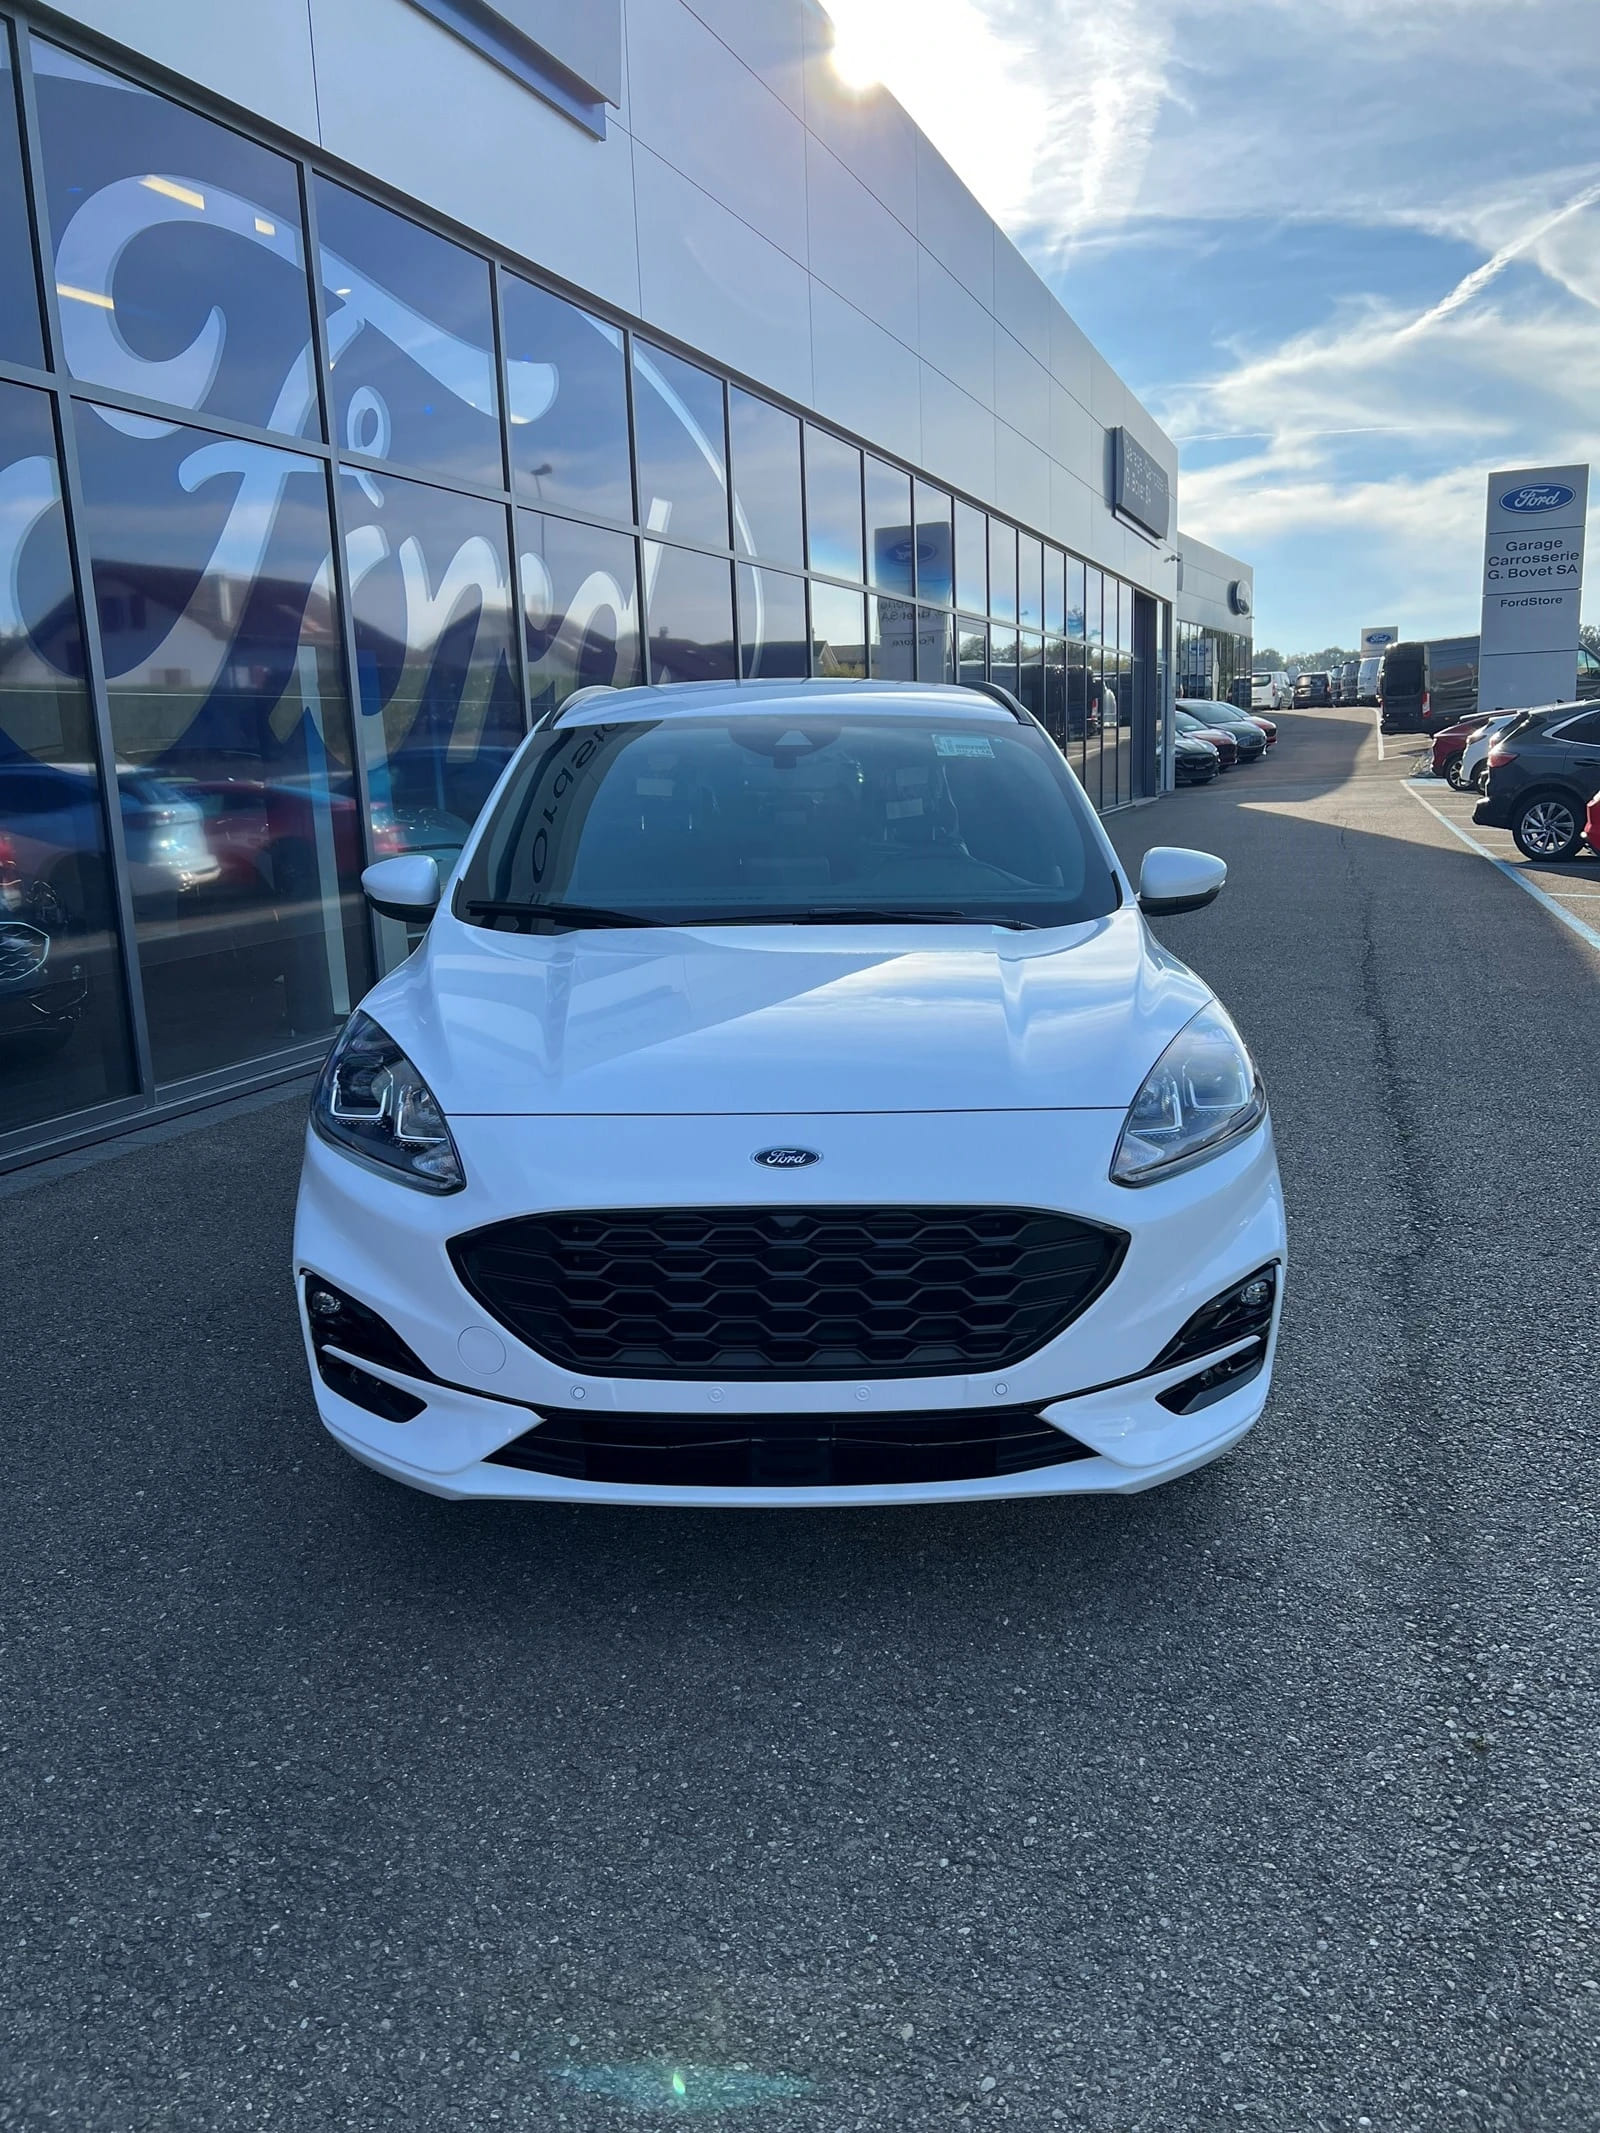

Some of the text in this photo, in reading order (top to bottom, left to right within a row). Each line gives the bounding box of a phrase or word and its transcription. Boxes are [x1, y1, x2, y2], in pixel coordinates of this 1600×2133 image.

[0, 173, 672, 778] Ford
[1514, 488, 1561, 507] Ford
[1505, 539, 1563, 552] Garage
[1488, 550, 1580, 567] Carrosserie
[1487, 563, 1578, 580] G. Bovet SA
[1500, 596, 1563, 608] FordStore
[766, 1149, 806, 1164] Ford
